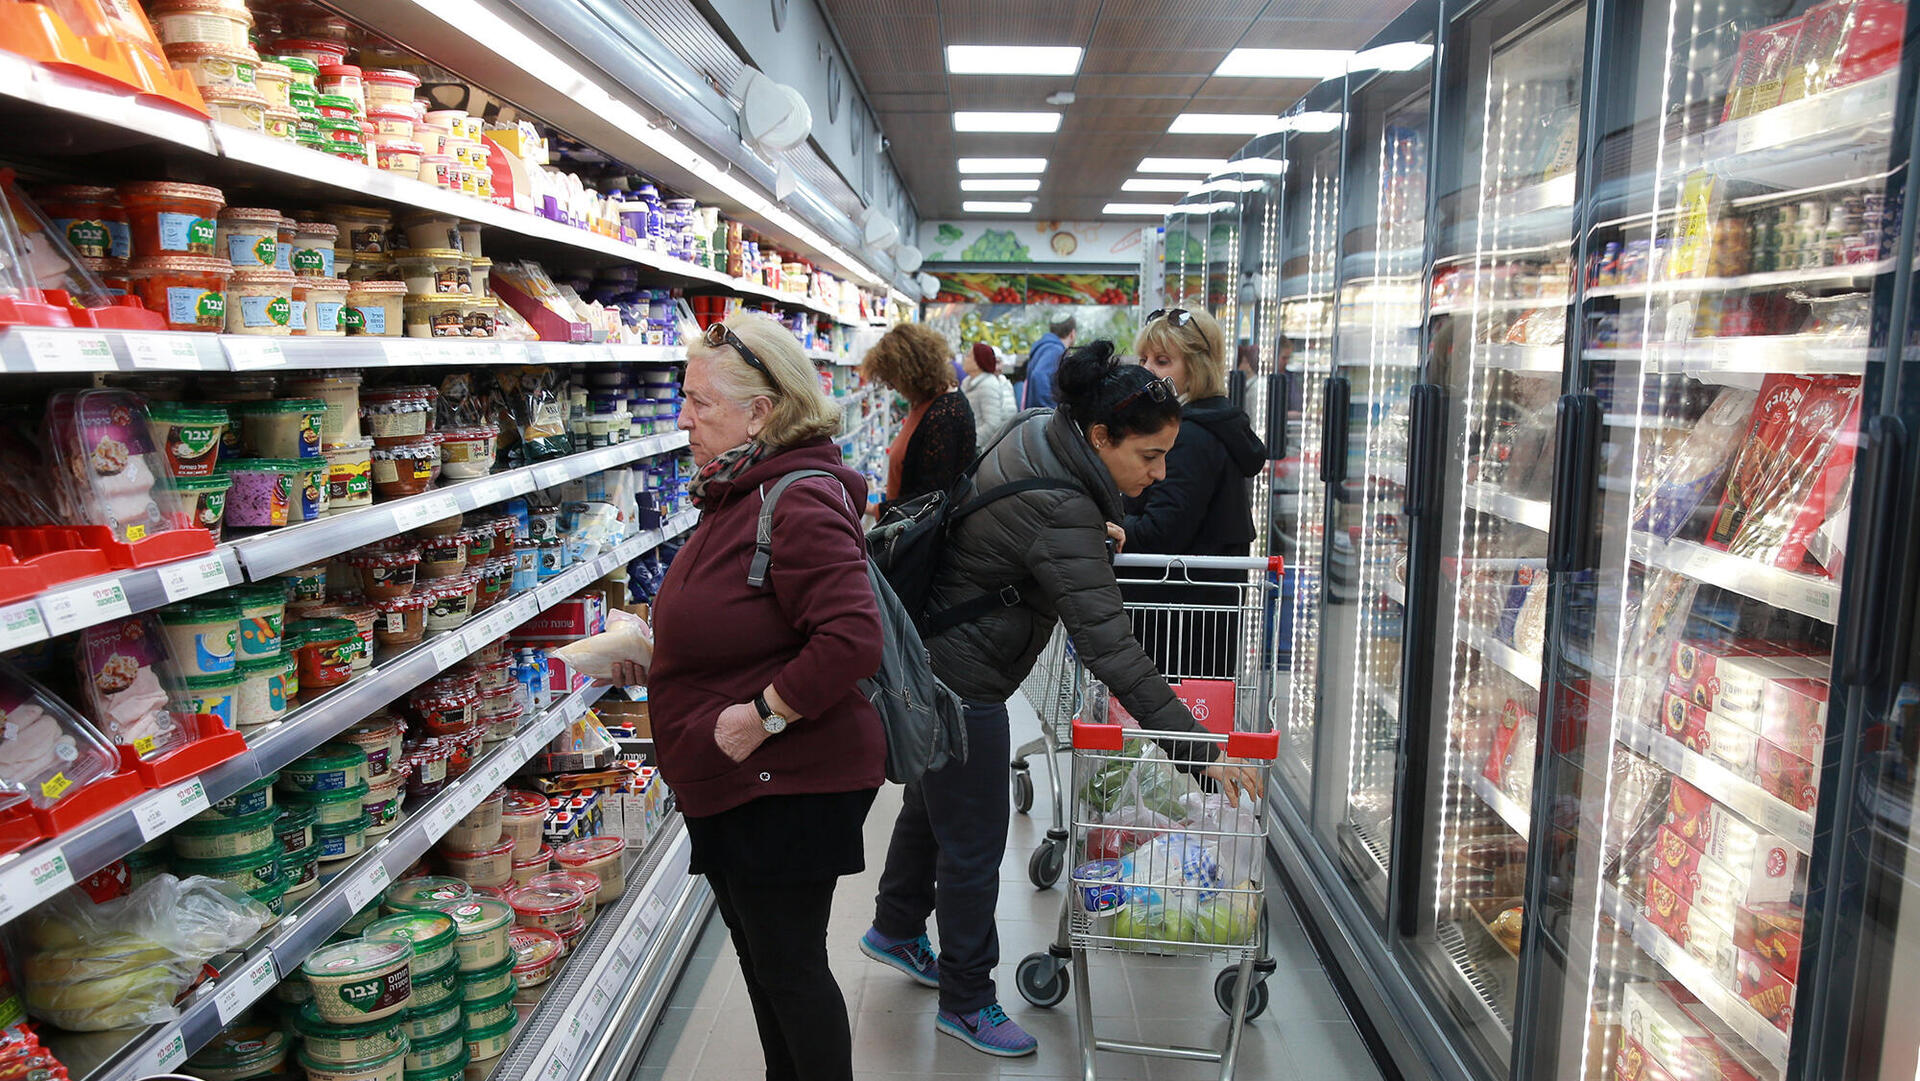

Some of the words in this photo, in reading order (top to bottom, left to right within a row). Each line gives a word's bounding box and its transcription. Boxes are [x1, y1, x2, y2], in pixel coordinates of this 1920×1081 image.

[73, 228, 103, 240] צבר
[194, 226, 214, 239] צבר
[260, 242, 275, 252] צבר
[298, 255, 320, 264] צבר
[203, 298, 223, 311] צבר
[272, 302, 289, 312] צבר
[311, 416, 322, 426] בר
[184, 430, 211, 441] צבר
[284, 478, 294, 487] בר
[349, 481, 368, 491] צבר
[209, 495, 224, 505] צבר
[298, 584, 318, 593] צבר
[552, 618, 575, 629] שמנת
[623, 753, 647, 761] שמנת
[256, 863, 273, 876] צבר
[343, 981, 379, 999] צבר
